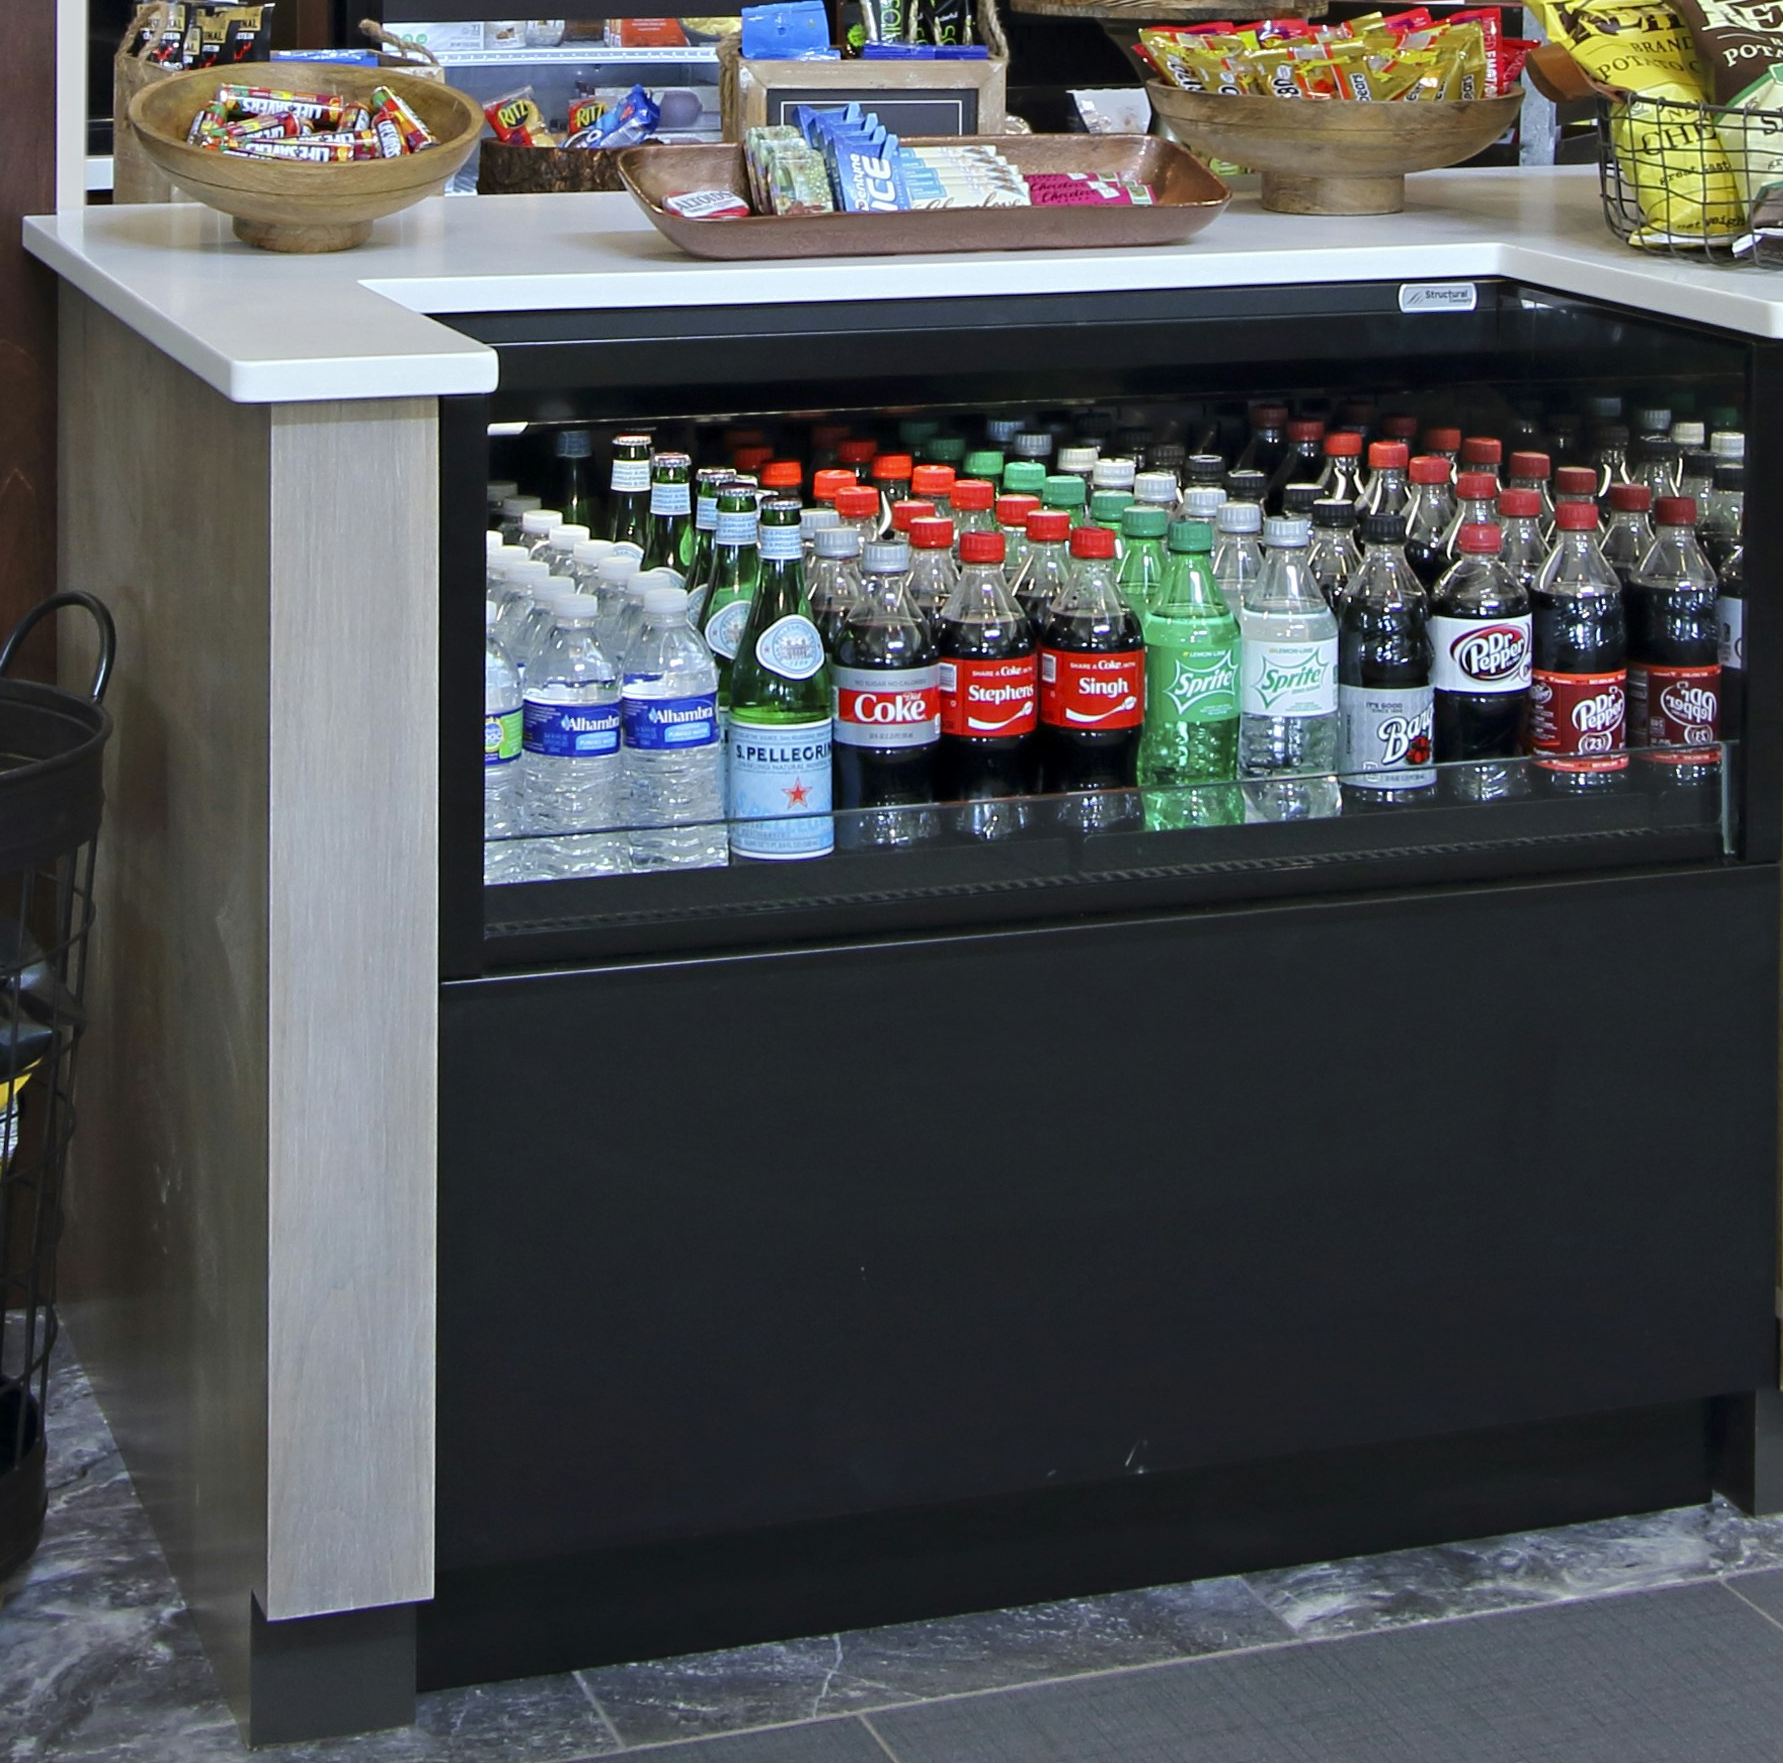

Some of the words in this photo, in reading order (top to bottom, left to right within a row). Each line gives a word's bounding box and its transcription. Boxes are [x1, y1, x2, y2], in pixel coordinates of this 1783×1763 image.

[1599, 54, 1686, 81] POTATO
[497, 101, 529, 129] RITZ
[574, 102, 605, 128] RITZ
[853, 153, 870, 212] Dentyne
[869, 154, 894, 212] ICE
[677, 191, 731, 210] ALTOIDS
[1425, 289, 1469, 301] Structural
[1489, 631, 1515, 652] Dr
[1097, 659, 1122, 671] Coke
[1467, 636, 1525, 676] Pepper
[1000, 665, 1023, 677] Coke
[1175, 666, 1235, 702] Sprite
[1263, 666, 1322, 694] Sprite
[968, 684, 1034, 706] Stephens
[1078, 676, 1130, 700] Singh
[654, 704, 714, 724] Alhambra
[854, 694, 927, 724] Coke
[1594, 692, 1617, 712] Dr
[1574, 697, 1625, 735] Pepper
